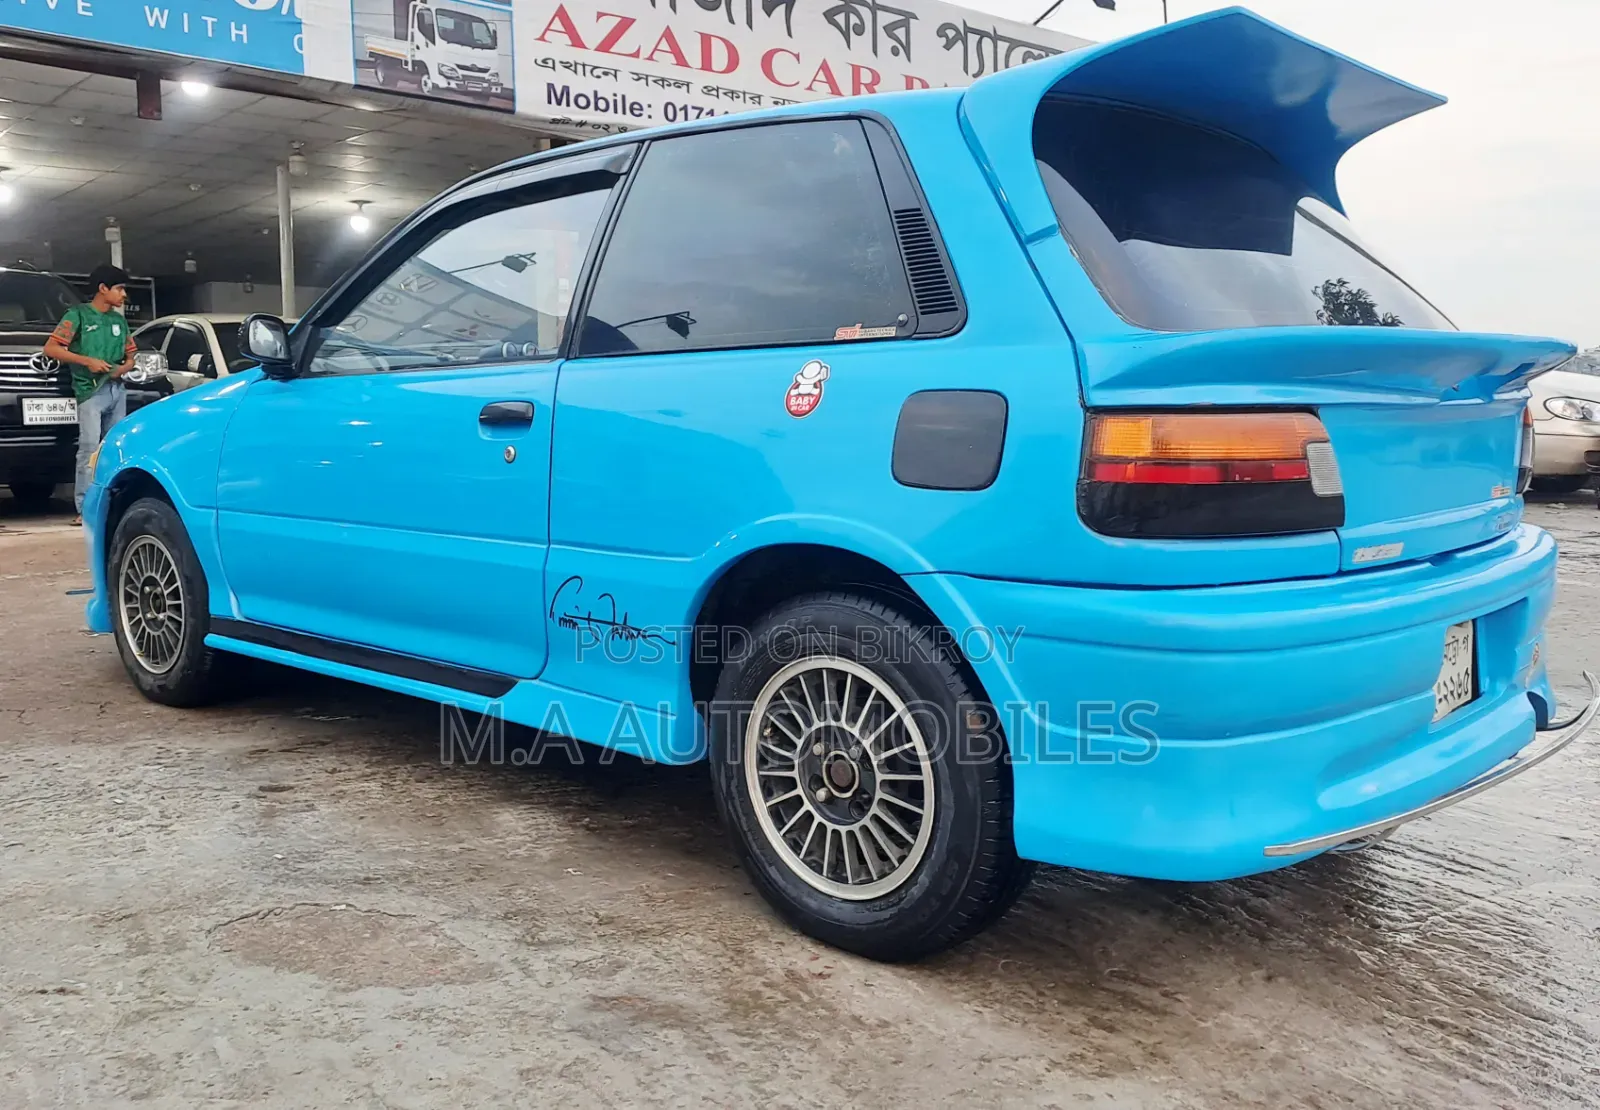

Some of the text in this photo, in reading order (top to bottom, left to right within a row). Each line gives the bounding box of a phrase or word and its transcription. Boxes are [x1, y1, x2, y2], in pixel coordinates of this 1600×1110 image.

[144, 5, 248, 44] WITH
[823, 0, 919, 63] কার
[534, 3, 881, 97] AZAD CAR
[534, 56, 622, 82] এখানে
[629, 71, 694, 95] সকল
[701, 85, 764, 106] প্রকার
[546, 83, 652, 120] Mobile:
[790, 396, 816, 405] BABY
